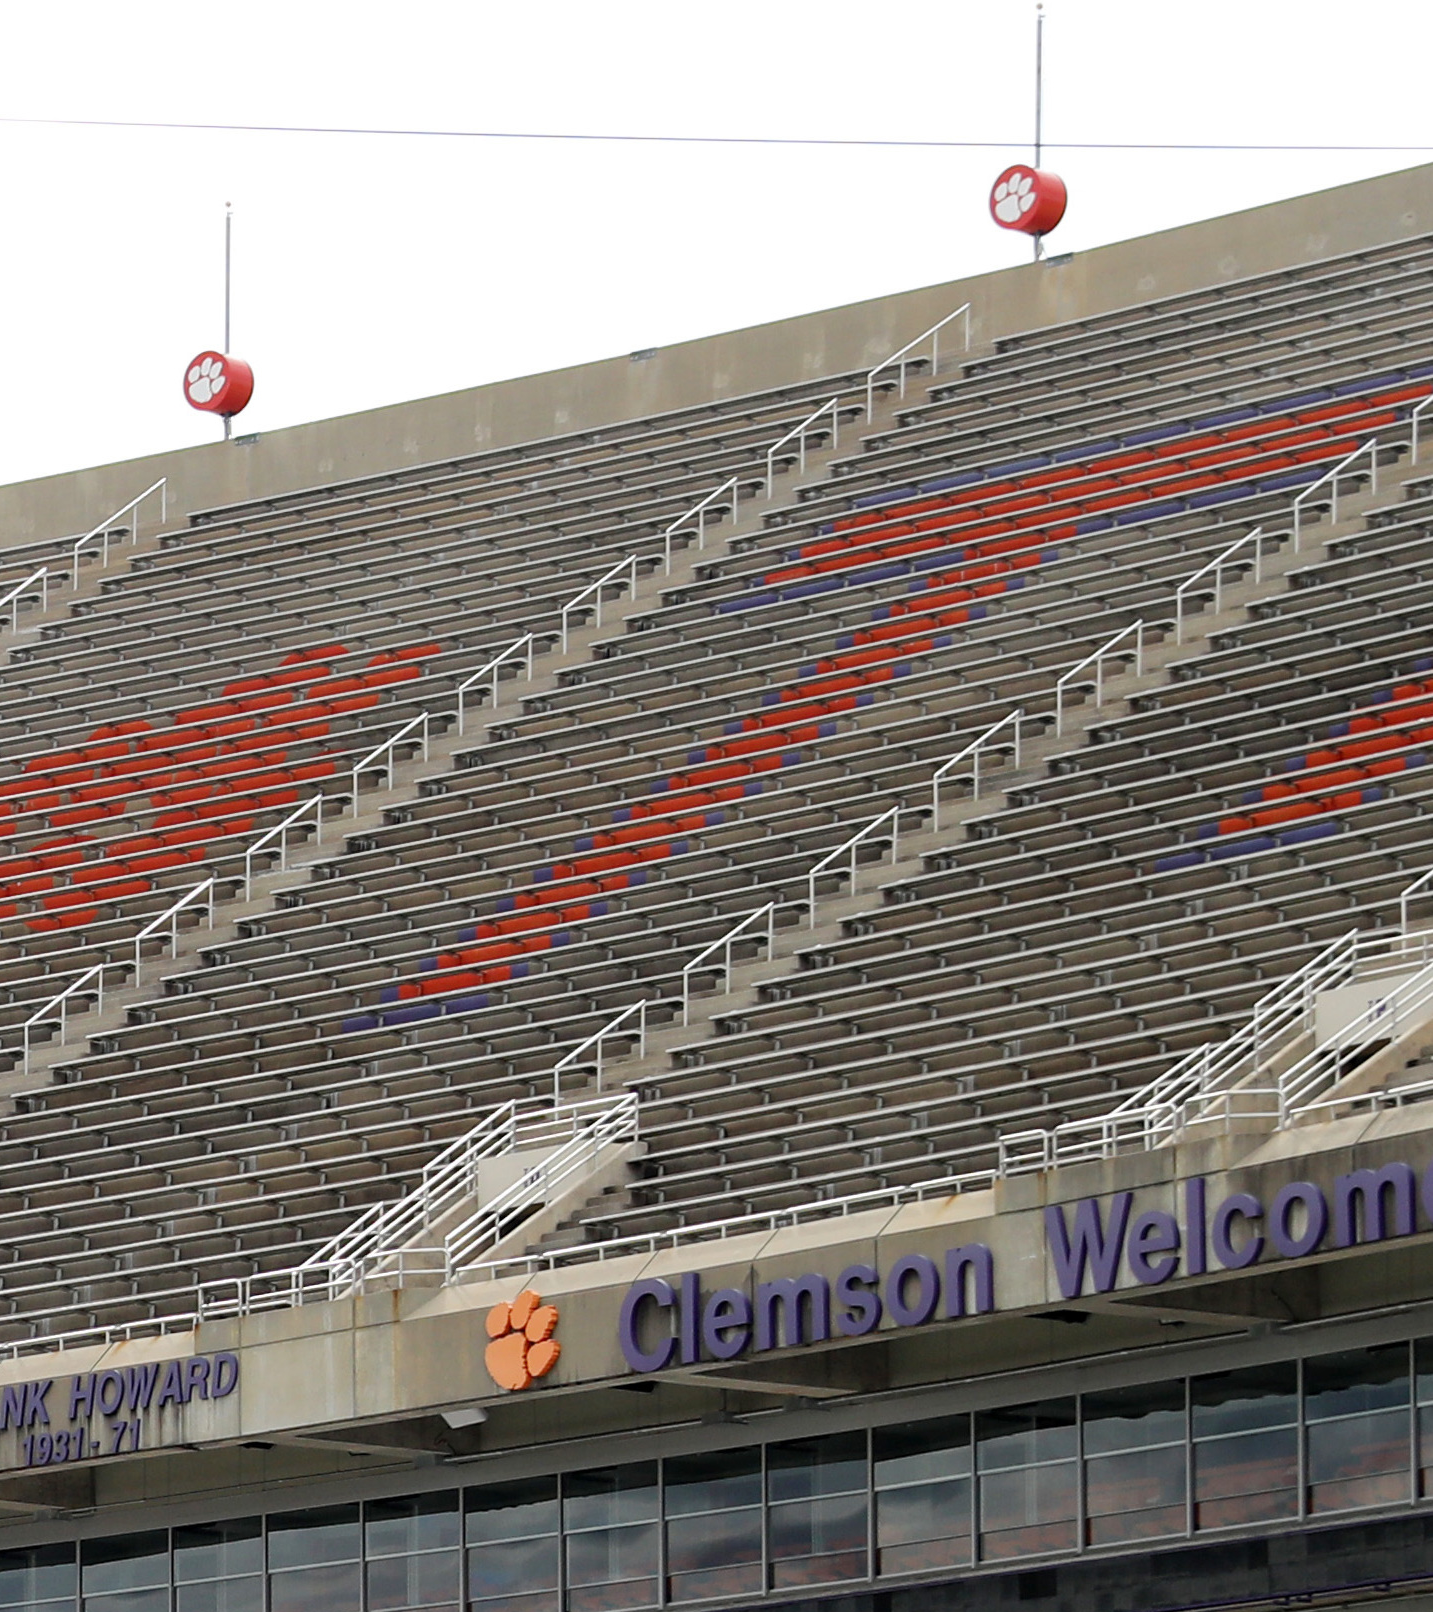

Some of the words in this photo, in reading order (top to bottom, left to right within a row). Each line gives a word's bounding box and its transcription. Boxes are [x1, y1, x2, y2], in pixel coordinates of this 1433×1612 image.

[619, 1242, 995, 1373] Clemson
[1044, 1157, 1433, 1299] Welcom
[69, 1352, 239, 1420] HOWARD
